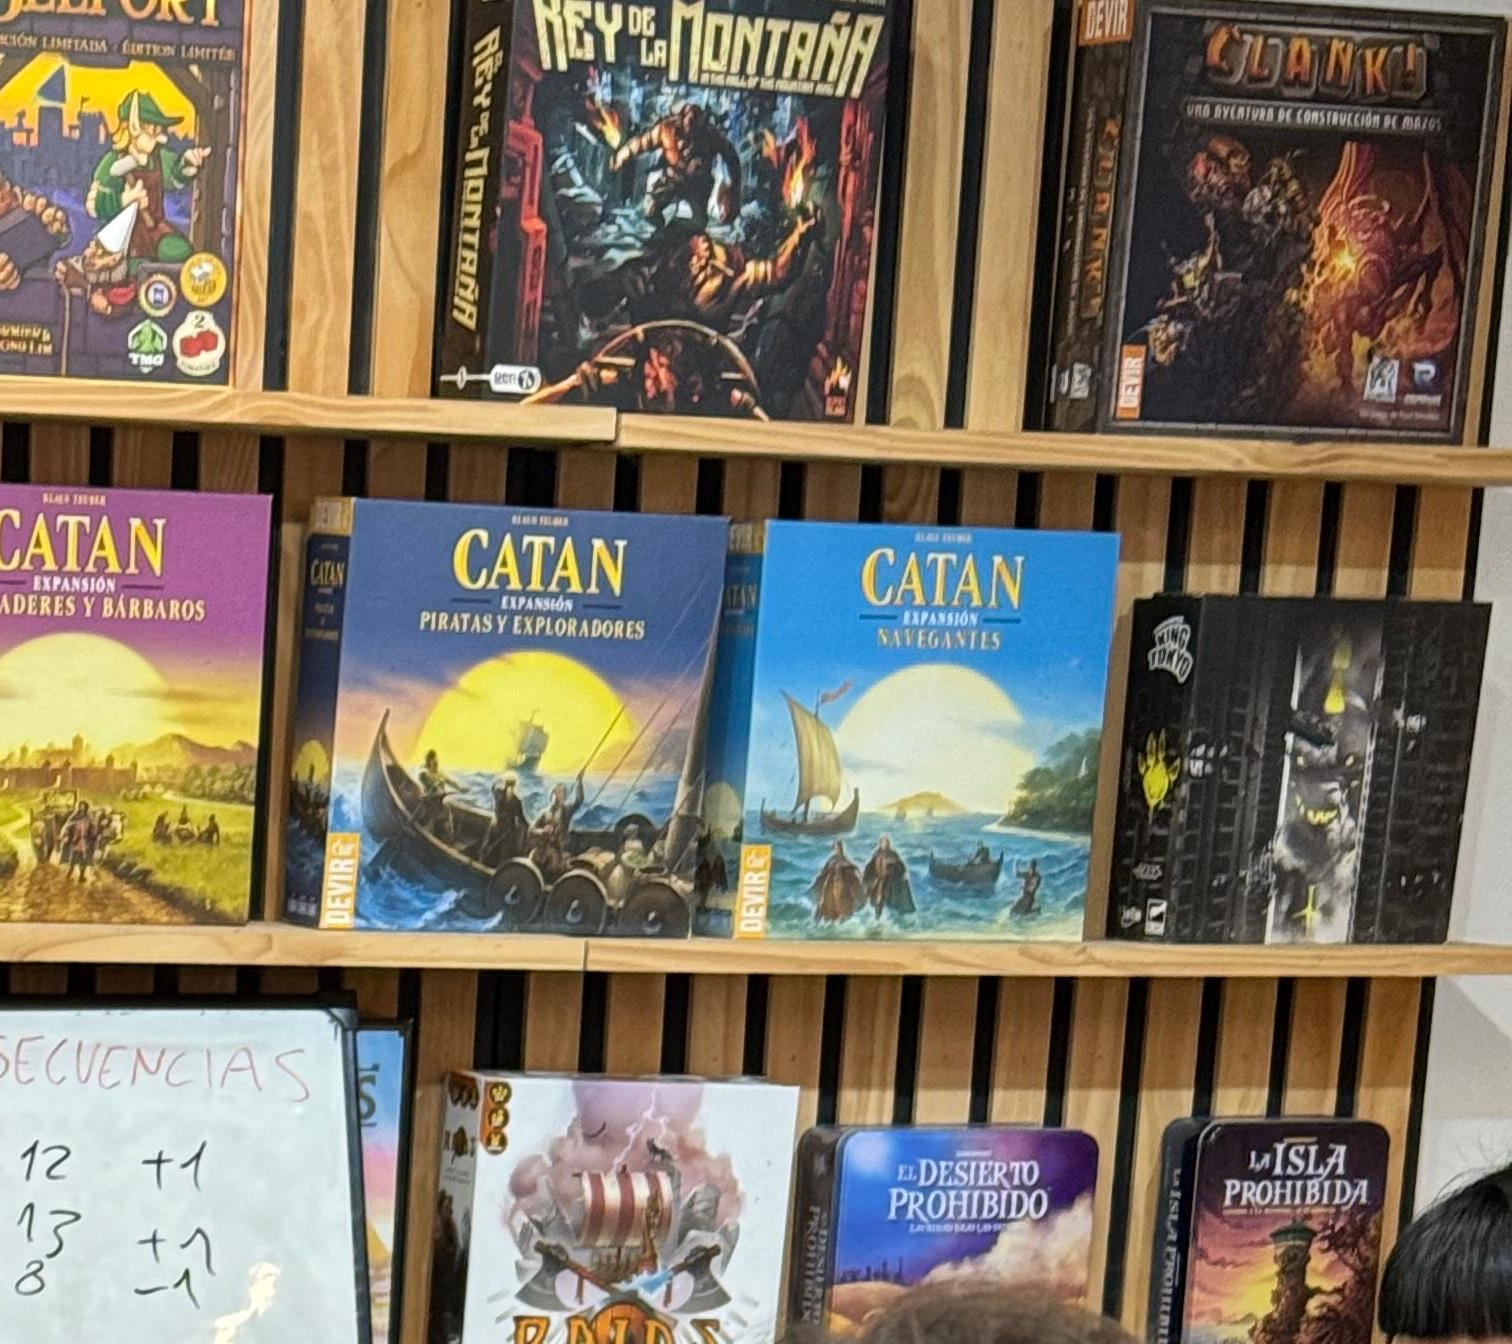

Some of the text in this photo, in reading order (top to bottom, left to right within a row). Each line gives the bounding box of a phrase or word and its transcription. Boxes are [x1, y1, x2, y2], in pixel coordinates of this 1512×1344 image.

[533, 0, 885, 98] REY DE LA MONTAÑA
[1205, 23, 1418, 95] CLANK!
[1213, 104, 1274, 122] AVENTURA
[1296, 108, 1380, 128] CONSTRUCCIÓN
[1121, 357, 1144, 407] DEVIR
[452, 528, 628, 597] CATAN
[861, 547, 1025, 609] CATAN
[33, 575, 116, 594] EXPANSIÓN
[501, 594, 574, 613] EXPANSIÓN
[83, 597, 95, 618] Y
[102, 594, 206, 622] BÁRBAROS
[420, 610, 646, 641] PIRATAS Y EXPLORADORES
[902, 608, 978, 627] EXPANSIÓN
[876, 628, 1002, 651] NAVEGANTES
[327, 859, 356, 928] DEVIR
[740, 872, 767, 933] DEVIR
[20, 1140, 71, 1182] 12
[142, 1141, 207, 1193] +1
[898, 1158, 1040, 1189] EL DESIERTO
[1249, 1141, 1349, 1181] LA ISLA
[888, 1186, 1050, 1222] PROHIBIDO
[1222, 1176, 1371, 1210] PROHIBIDA
[17, 1202, 82, 1259] 13
[138, 1227, 216, 1277] +1
[15, 1260, 46, 1296] 8
